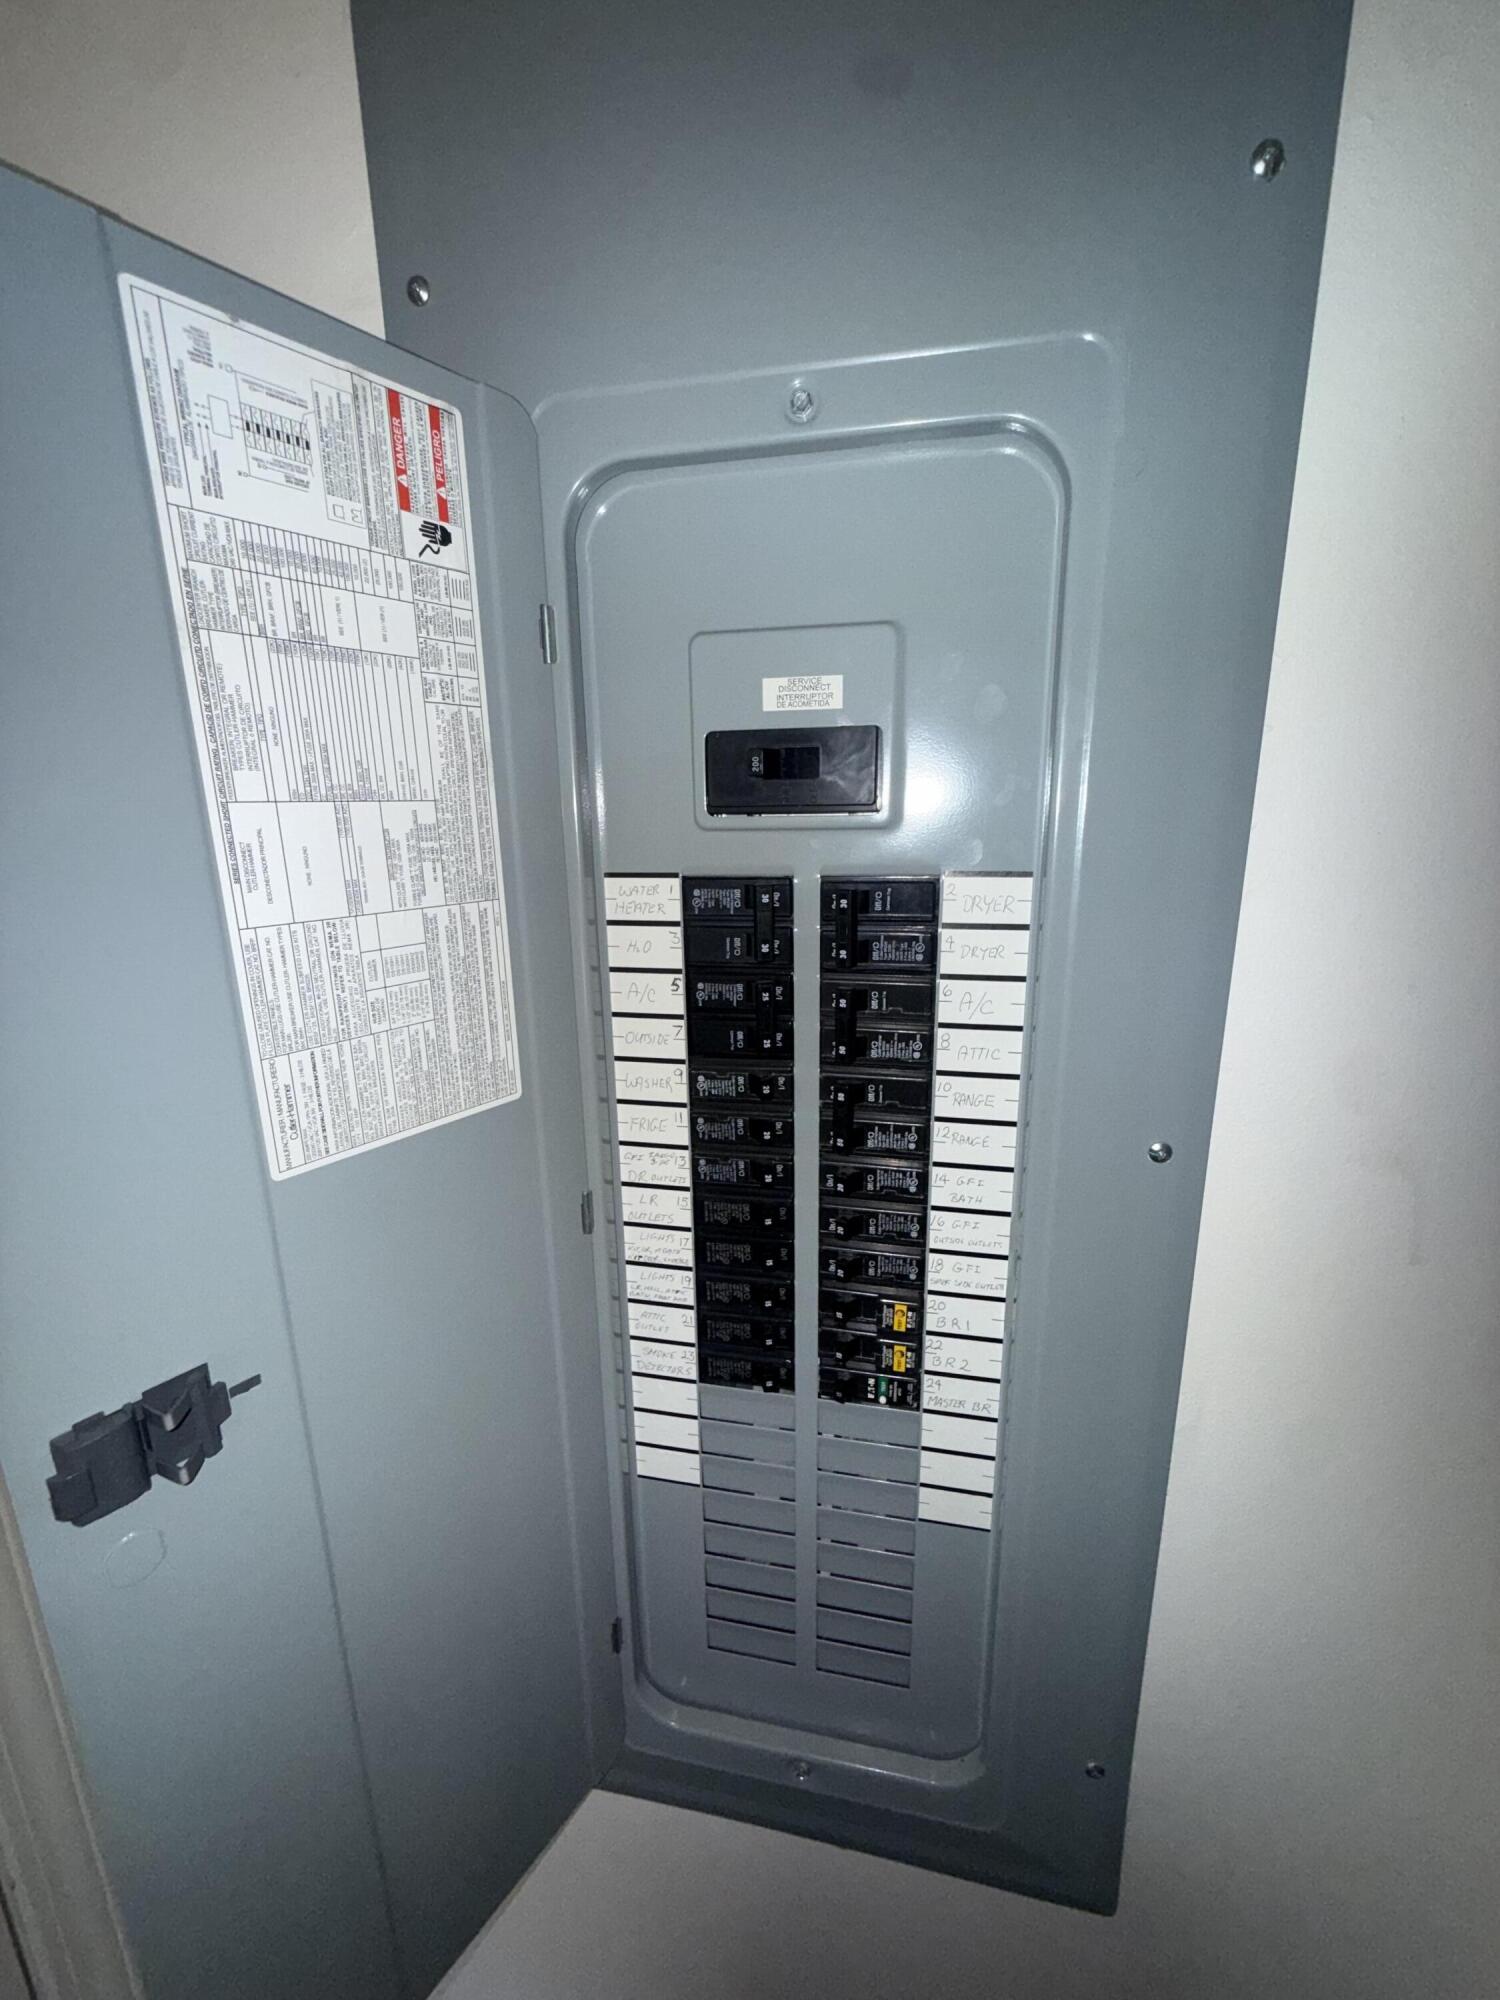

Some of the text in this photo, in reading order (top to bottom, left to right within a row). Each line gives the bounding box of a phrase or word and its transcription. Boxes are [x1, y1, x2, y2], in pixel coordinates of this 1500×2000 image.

[393, 418, 405, 468] DANGER
[432, 431, 443, 481] PELIGRO
[787, 676, 822, 685] SERVICE
[778, 684, 831, 692] DISCONNECT
[776, 692, 833, 701] INTERRUPTOR
[618, 885, 660, 897] WATER
[947, 883, 956, 896] 2
[761, 893, 769, 903] 30
[840, 899, 848, 909] 30
[963, 895, 1016, 913] DRYER
[615, 902, 666, 915] HEATER
[669, 931, 681, 944] 3
[761, 943, 769, 953] 30
[839, 950, 847, 959] 30
[961, 944, 1005, 960] DRYER
[628, 978, 681, 1003] A/C 5
[943, 985, 952, 997] 6
[959, 991, 995, 1020] A/C
[625, 1025, 683, 1045] OUTSIDE 7
[941, 1033, 950, 1048] 8
[957, 1046, 1000, 1061] ATTIC
[625, 1069, 683, 1092] WASHER 9
[936, 1082, 952, 1093] 10
[952, 1092, 995, 1108] RANGE
[284, 1084, 298, 1140] Cutler-Hammer
[629, 1112, 683, 1132] FRIGE 11
[935, 1127, 950, 1138] 12
[951, 1132, 991, 1148] RANGE
[674, 1155, 687, 1167] 13
[628, 1170, 648, 1182] DR
[934, 1173, 985, 1187] 14 GFI
[639, 1194, 689, 1208] LR 15
[950, 1193, 983, 1204] BATH
[930, 1215, 981, 1229] 16 GFI
[679, 1238, 690, 1247] 17
[930, 1256, 981, 1274] 18 GFI
[681, 1276, 692, 1286] 19
[927, 1300, 946, 1311] 20
[681, 1315, 693, 1326] 21
[926, 1340, 944, 1351] 22
[681, 1351, 695, 1362] 23
[960, 1359, 971, 1372] 2
[926, 1396, 992, 1415] MASTER BR
